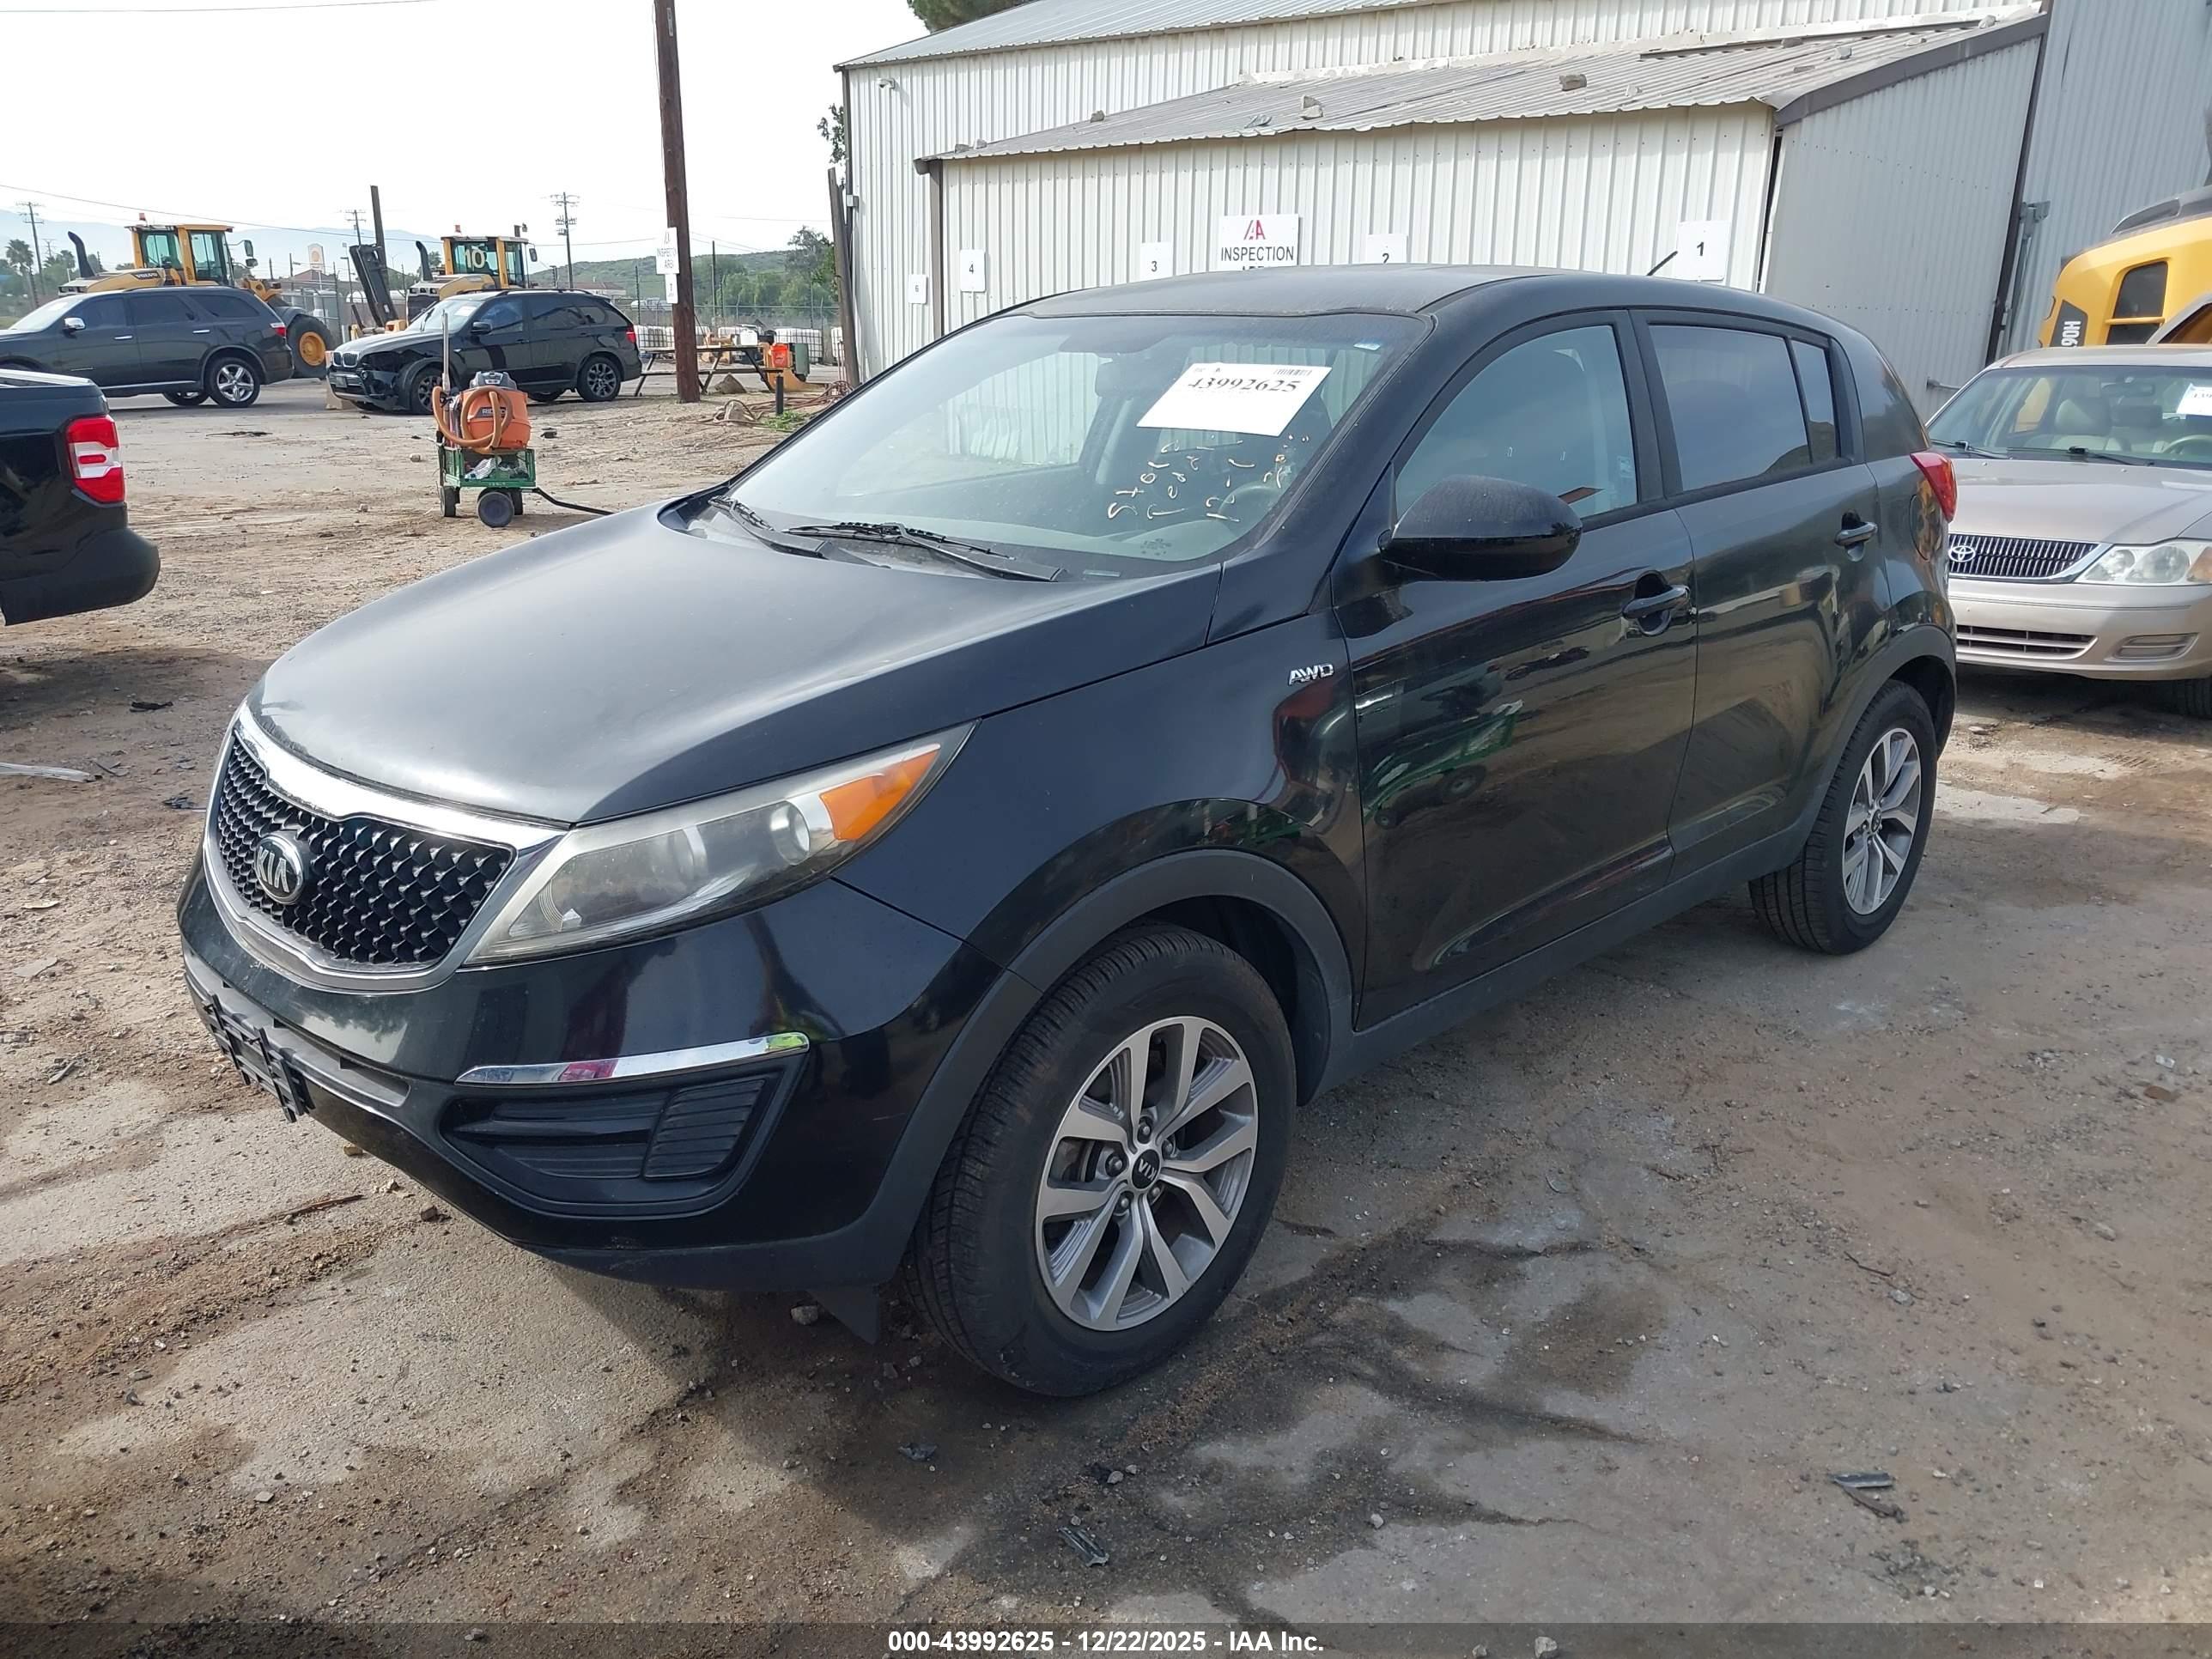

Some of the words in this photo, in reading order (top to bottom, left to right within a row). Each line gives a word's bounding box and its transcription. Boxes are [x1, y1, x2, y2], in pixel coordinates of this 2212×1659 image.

[1220, 246, 1295, 262] INSPECTION
[1696, 241, 1705, 257] 1
[465, 248, 486, 269] 10
[1151, 260, 1158, 272] 3
[1382, 252, 1390, 264] 2
[969, 263, 975, 274] 4
[1288, 662, 1334, 686] AWD
[257, 845, 290, 894] KIA
[1138, 1158, 1158, 1182] KIA
